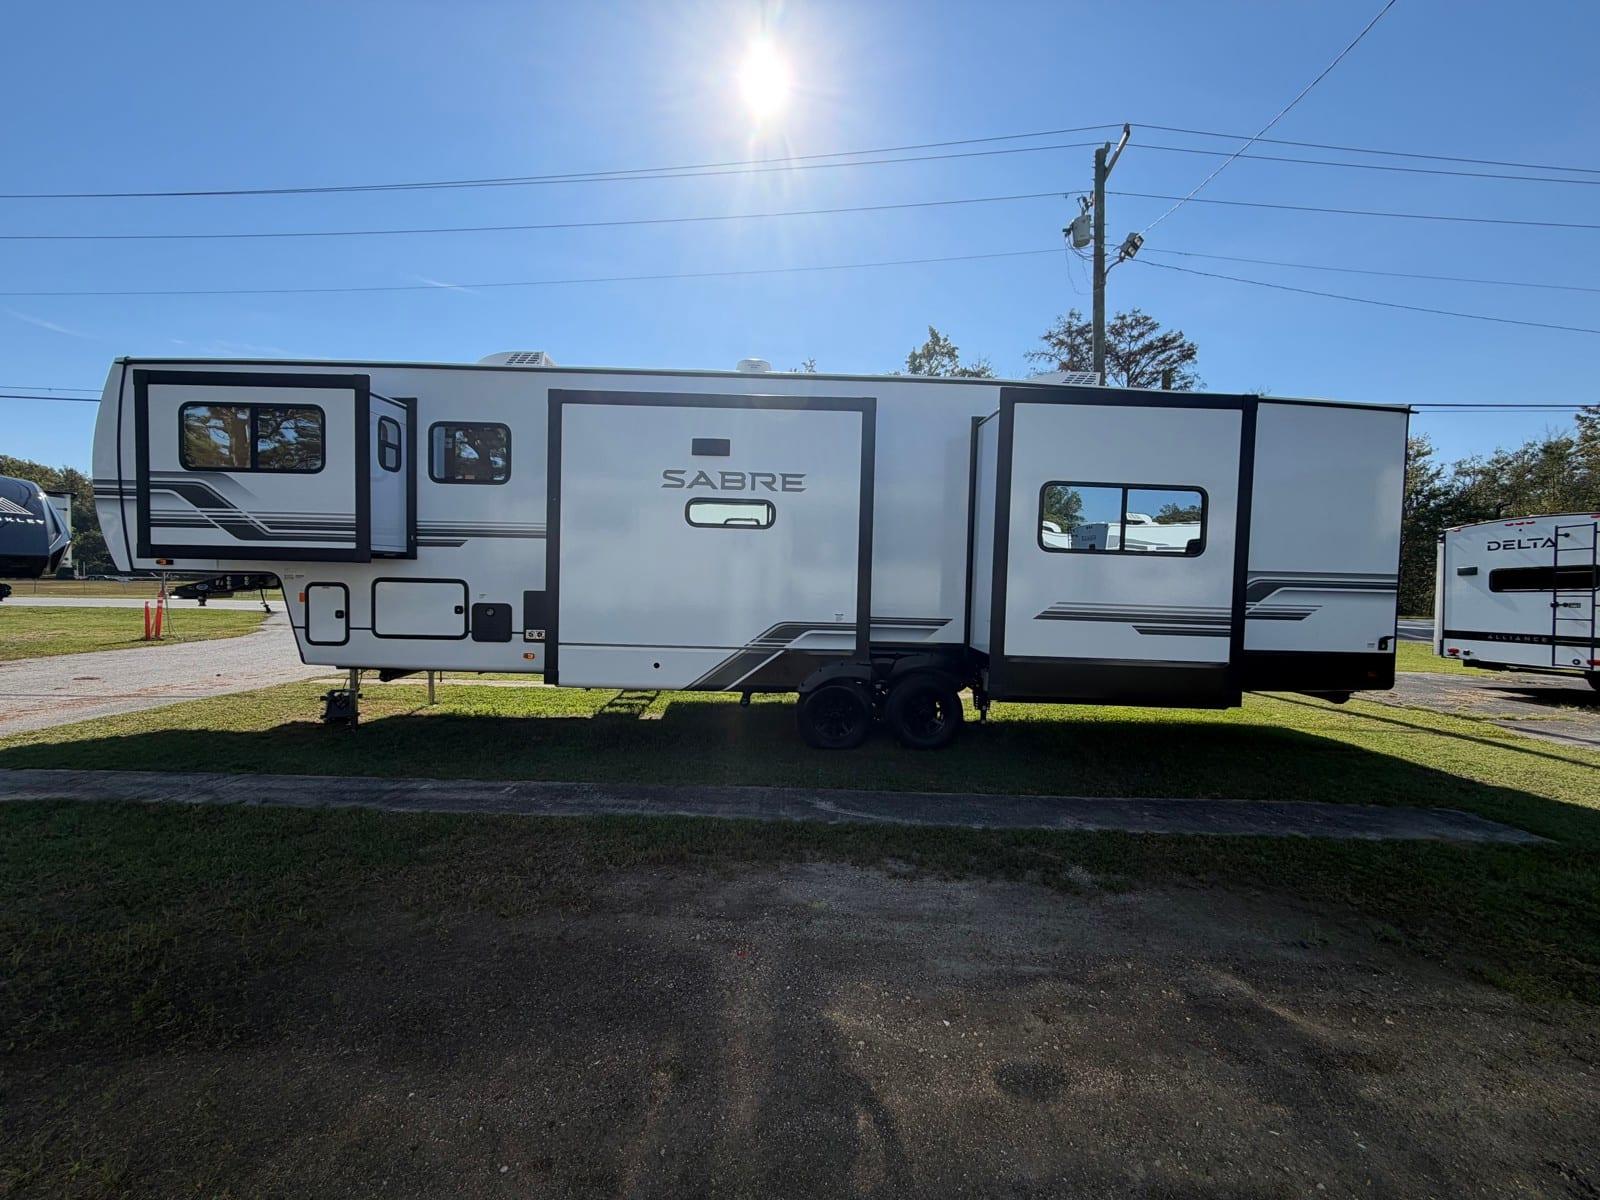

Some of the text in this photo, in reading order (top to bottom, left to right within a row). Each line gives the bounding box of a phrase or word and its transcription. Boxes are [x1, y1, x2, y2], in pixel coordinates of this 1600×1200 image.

[660, 469, 808, 493] SABRE
[1487, 537, 1556, 551] DELTA
[1487, 634, 1549, 643] ALLIANCE
